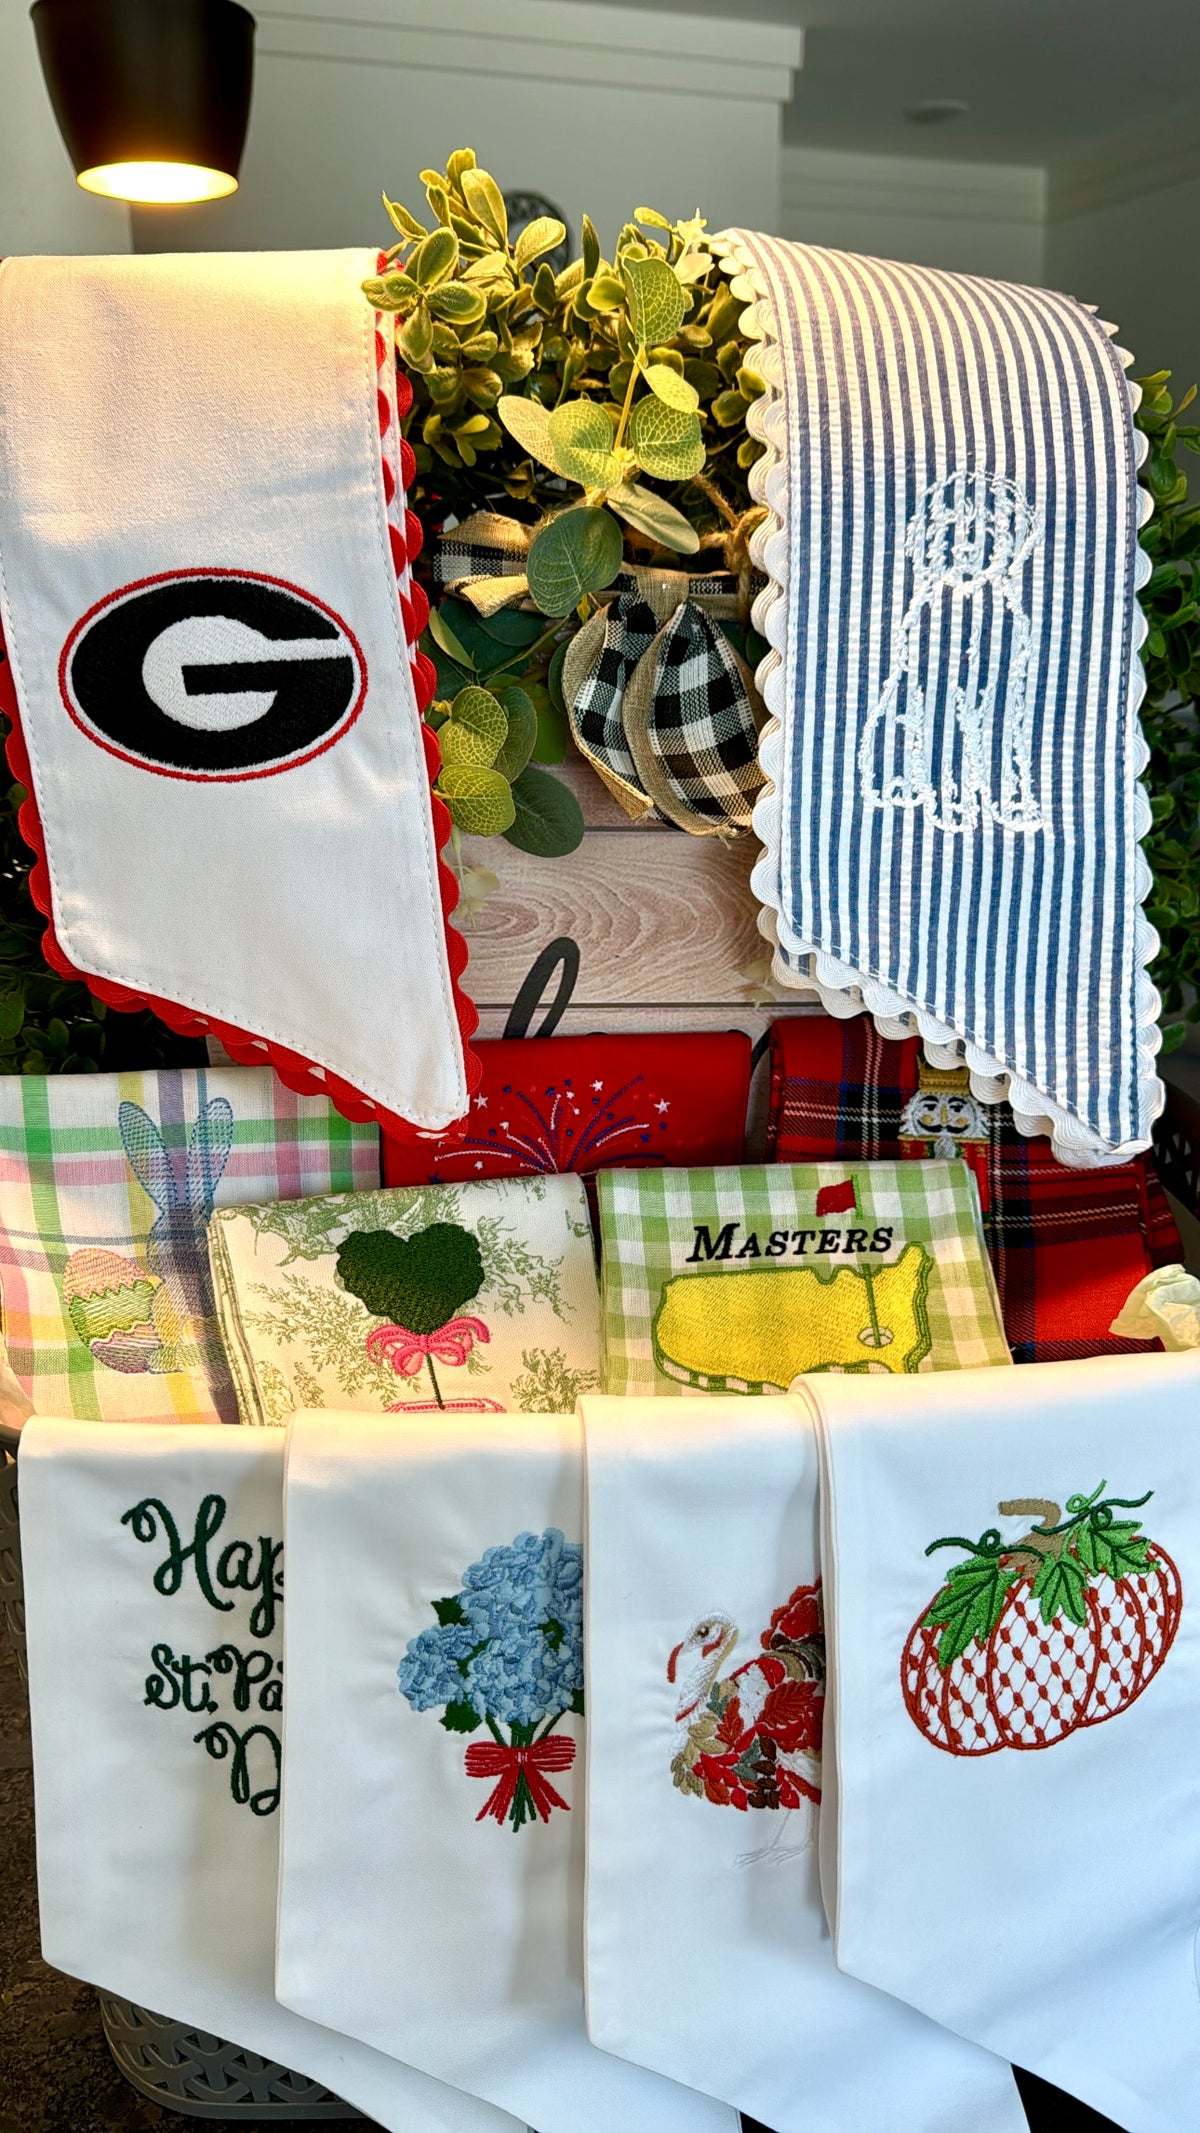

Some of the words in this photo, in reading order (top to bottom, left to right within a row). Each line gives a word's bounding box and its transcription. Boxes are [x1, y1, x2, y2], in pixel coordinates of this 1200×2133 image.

[71, 577, 355, 772] G
[685, 1222, 894, 1263] MASTERS
[143, 1643, 219, 1714] St.
